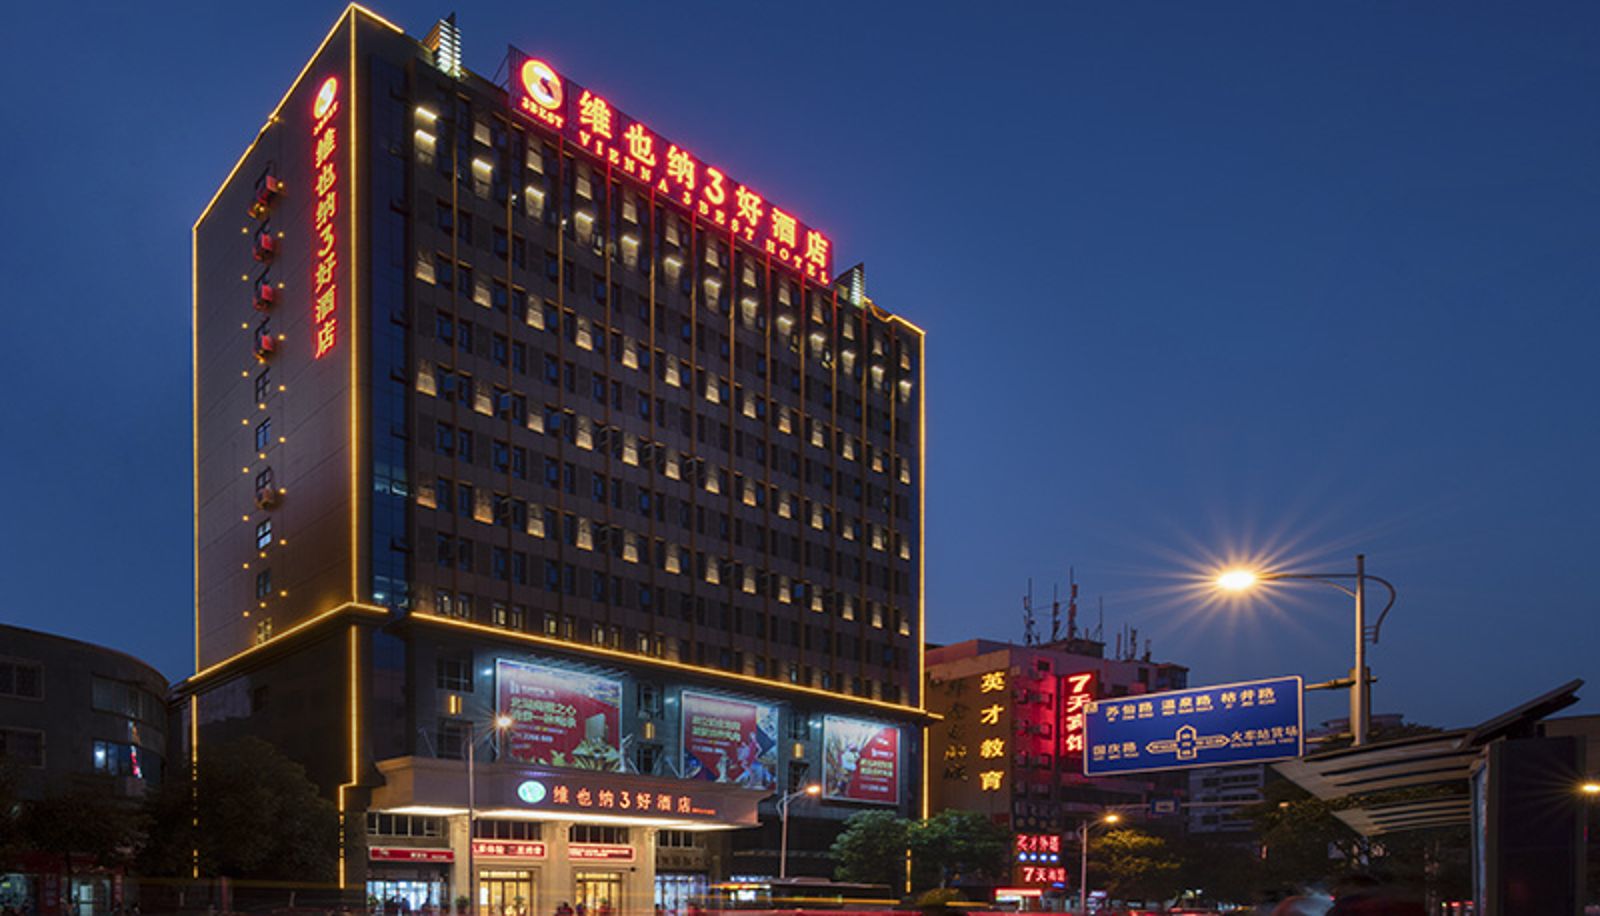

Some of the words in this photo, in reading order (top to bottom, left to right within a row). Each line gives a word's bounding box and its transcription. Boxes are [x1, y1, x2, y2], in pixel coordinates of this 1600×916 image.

[315, 127, 336, 360] 维也纳3好酒店
[579, 90, 829, 268] 维也纳3好酒店
[579, 131, 670, 193] VIENNA
[766, 239, 829, 284] HOTEL
[553, 785, 691, 813] 维也纳3好酒店
[980, 671, 1005, 791] 英才教育
